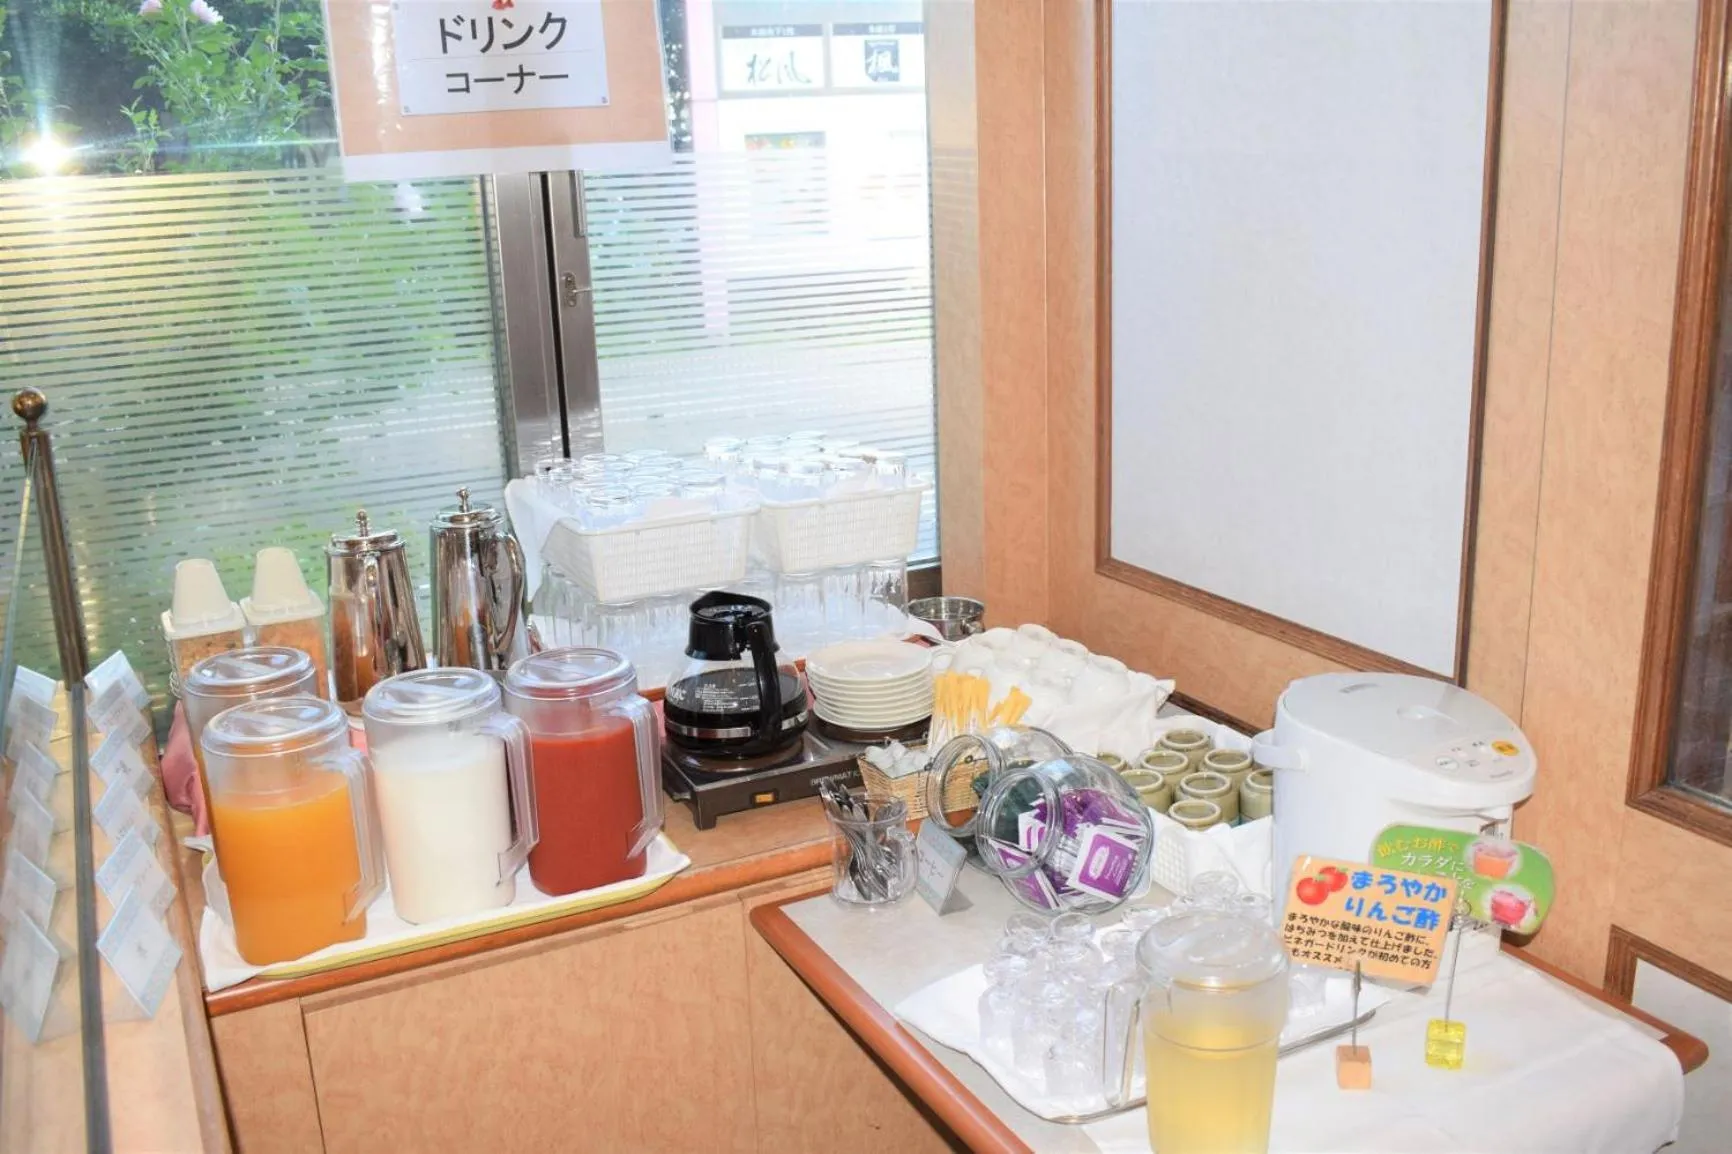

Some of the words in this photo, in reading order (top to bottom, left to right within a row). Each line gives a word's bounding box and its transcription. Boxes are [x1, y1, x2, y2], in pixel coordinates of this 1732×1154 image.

[439, 12, 567, 54] ドリンク
[446, 64, 569, 94] コーナー
[1351, 870, 1448, 903] まろやか
[1344, 896, 1441, 931] りんご酢
